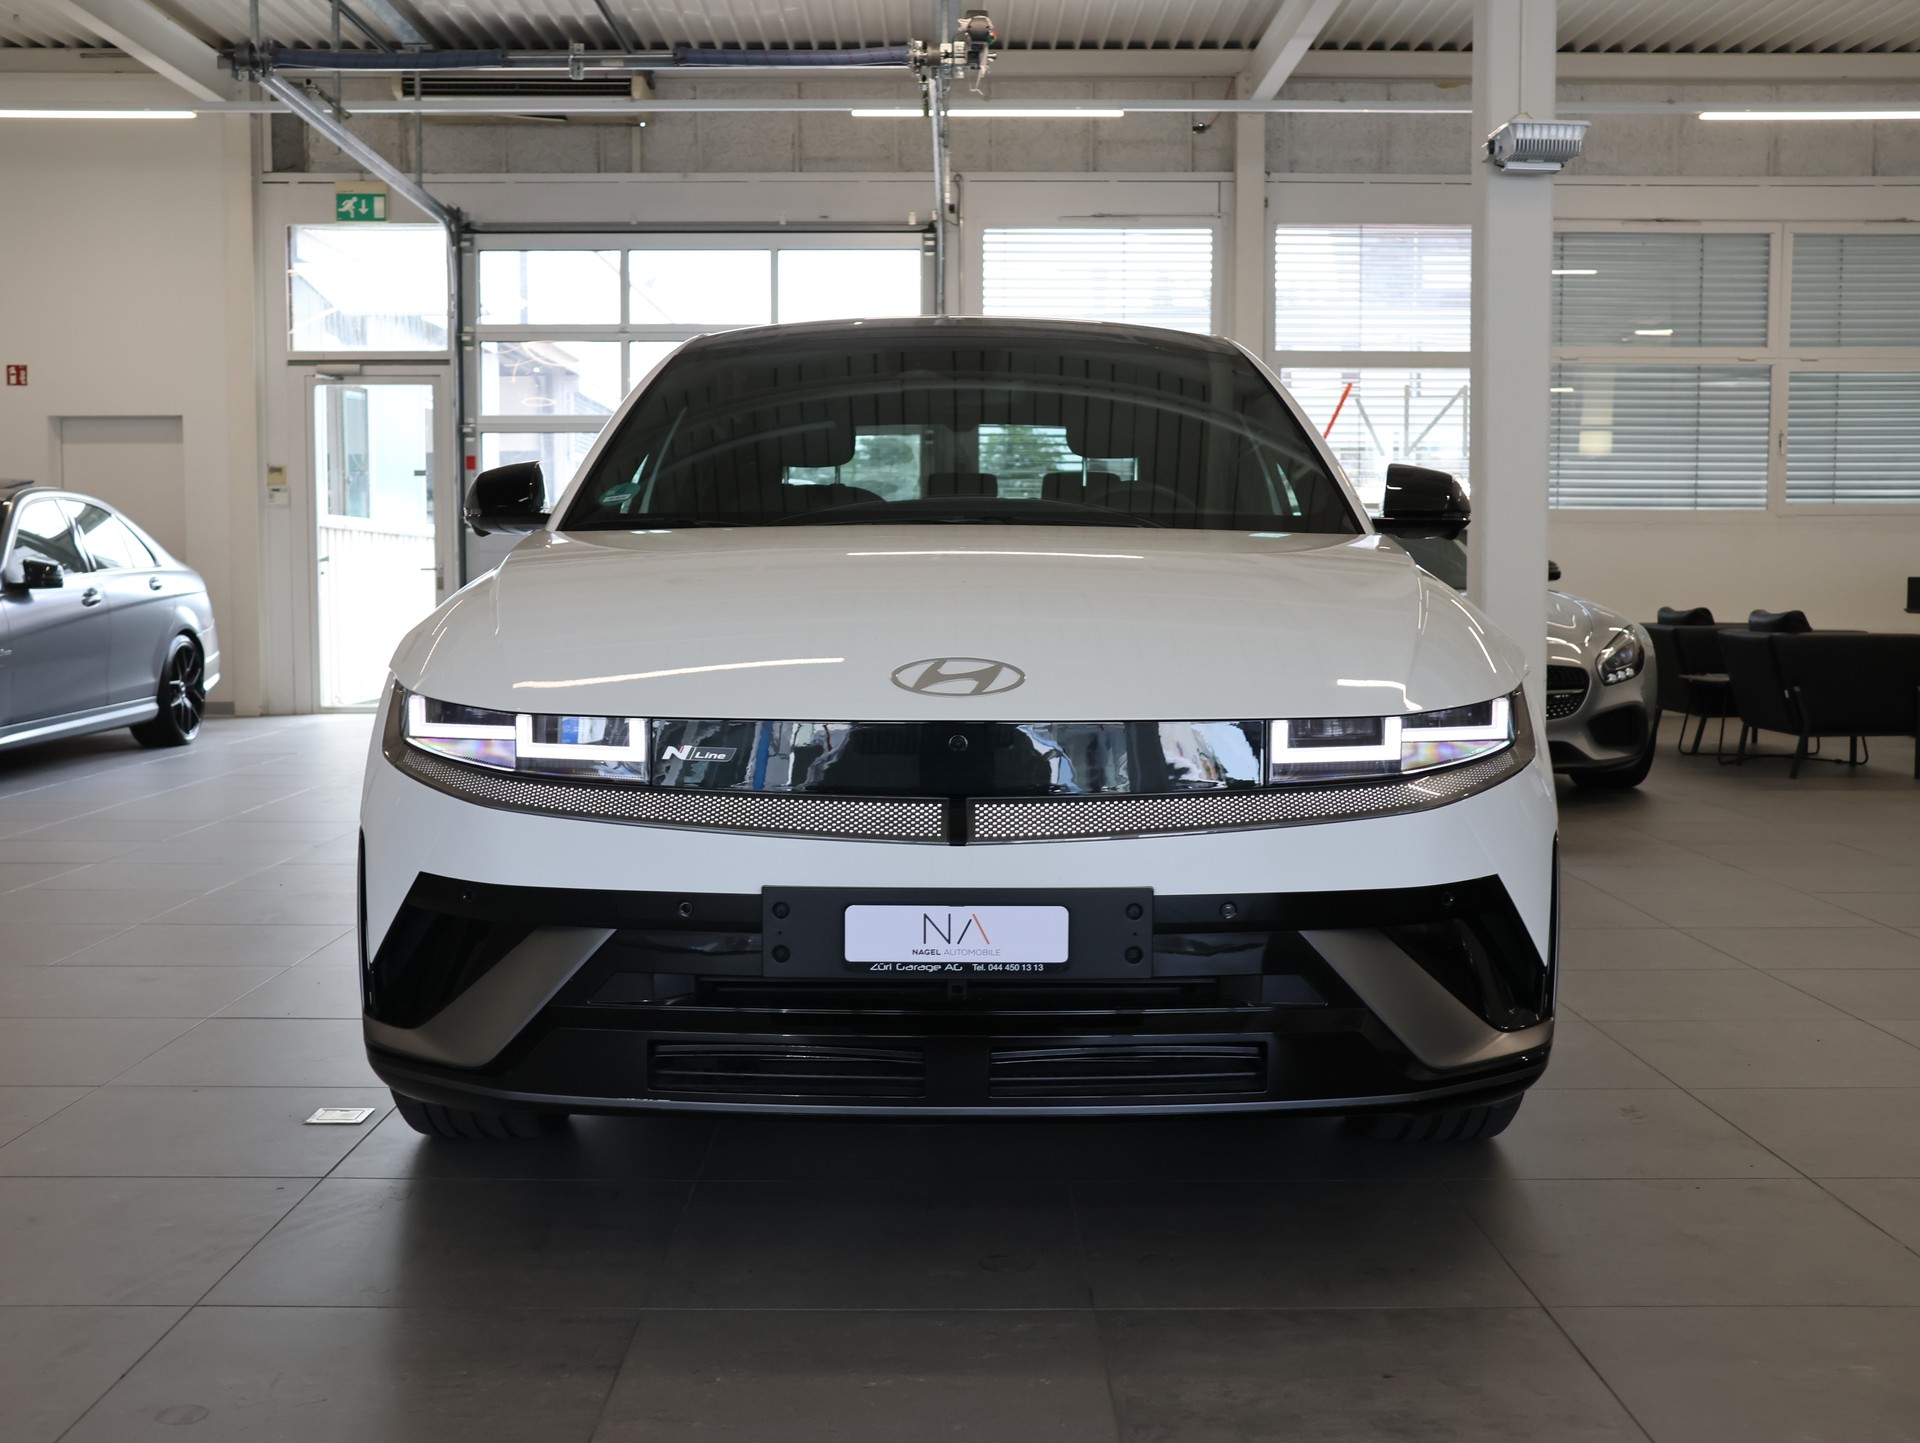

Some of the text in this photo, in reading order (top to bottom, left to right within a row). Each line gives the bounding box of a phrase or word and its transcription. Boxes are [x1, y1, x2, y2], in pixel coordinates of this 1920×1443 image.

[662, 745, 726, 760] N Line
[912, 948, 1001, 956] NAGEL AUTOMOBILE
[895, 963, 942, 972] Garage
[944, 963, 963, 971] AG
[972, 963, 986, 971] Tel.
[988, 963, 1003, 971] 044
[1004, 963, 1020, 971] 450
[1022, 963, 1032, 971] 13
[1034, 963, 1044, 971] 13
